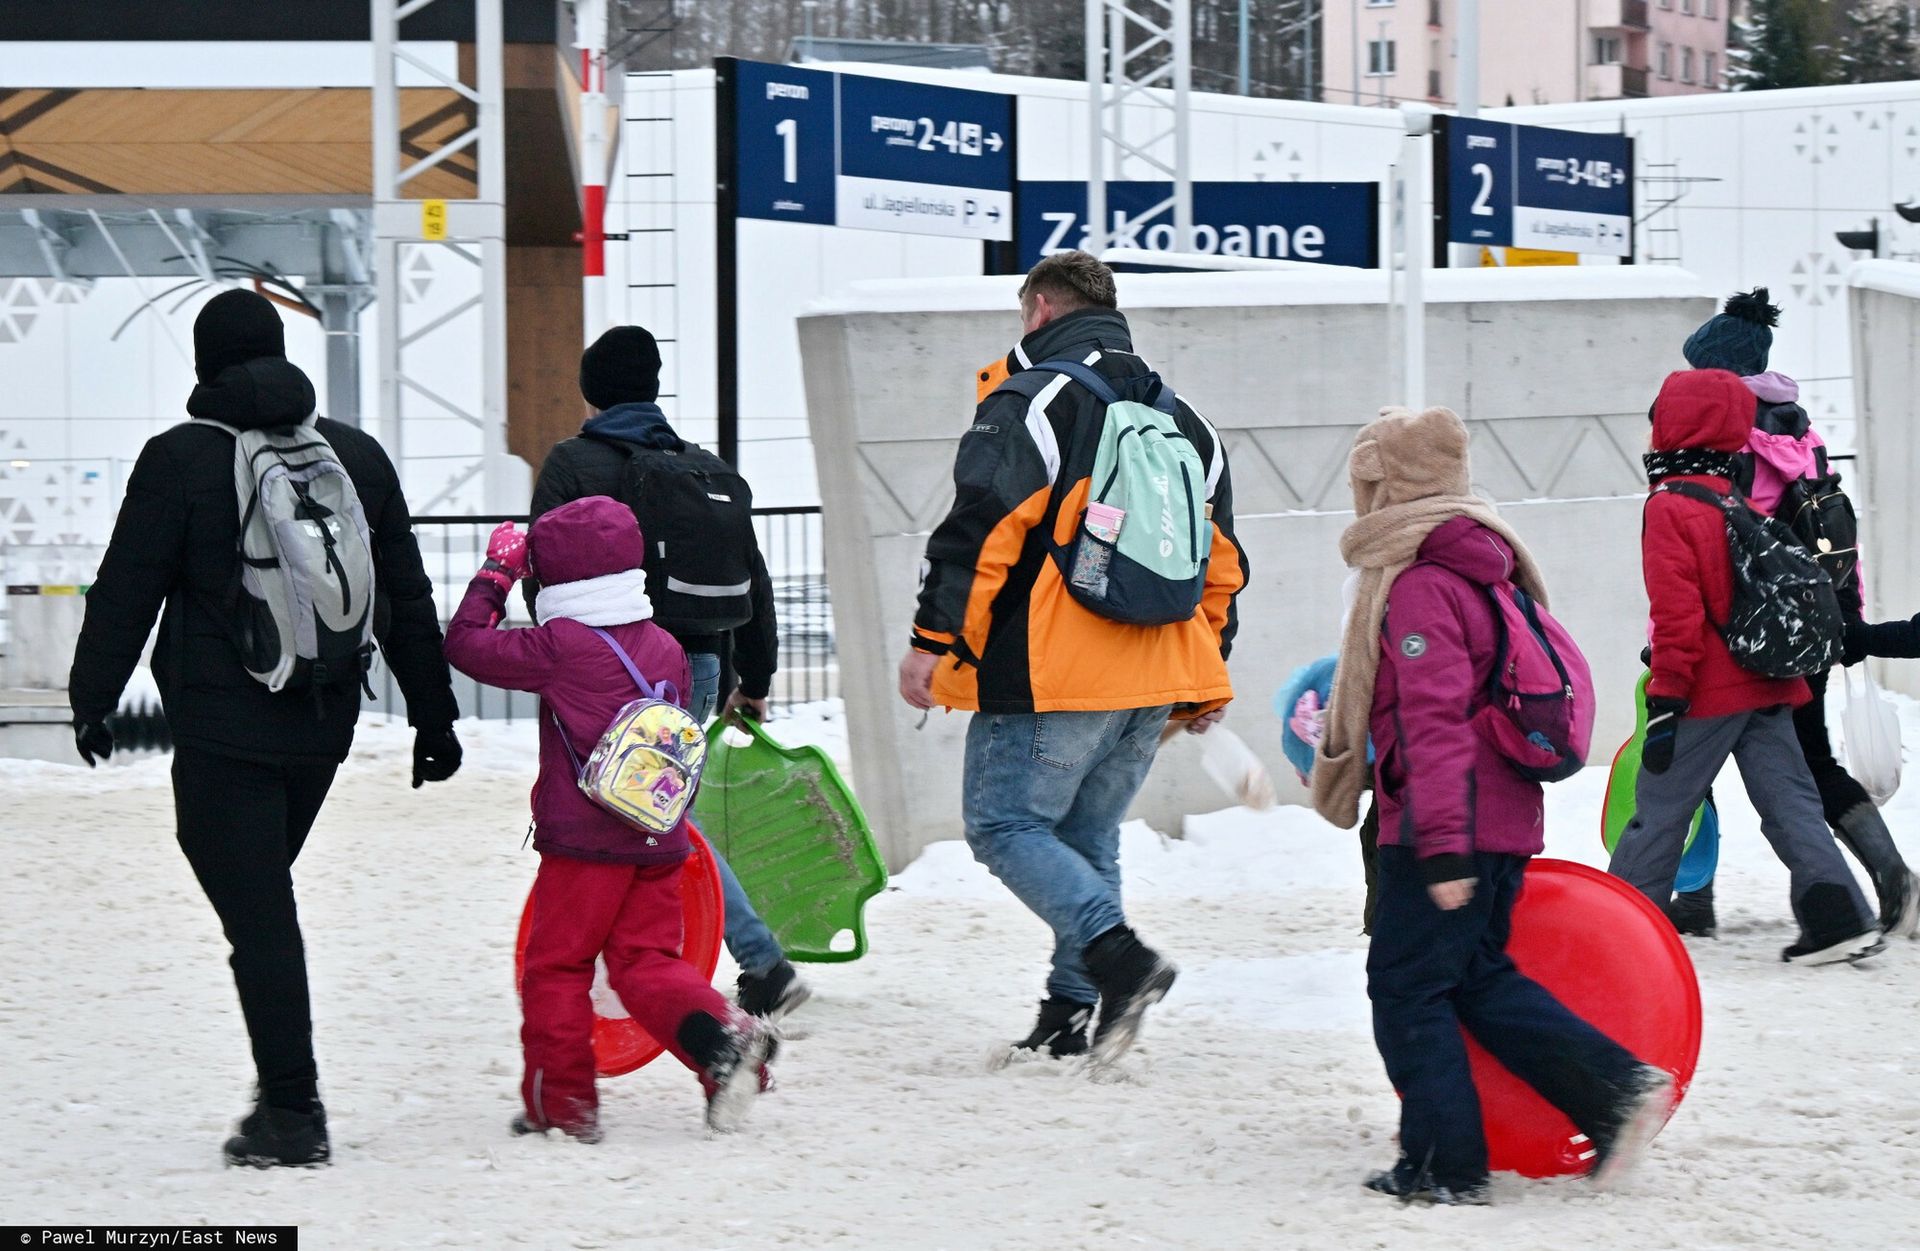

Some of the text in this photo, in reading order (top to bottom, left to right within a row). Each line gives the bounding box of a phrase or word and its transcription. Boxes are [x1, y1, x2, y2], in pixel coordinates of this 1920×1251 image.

[775, 118, 797, 183] 1
[1471, 163, 1494, 216] 2
[1039, 210, 1327, 258] Zakopane
